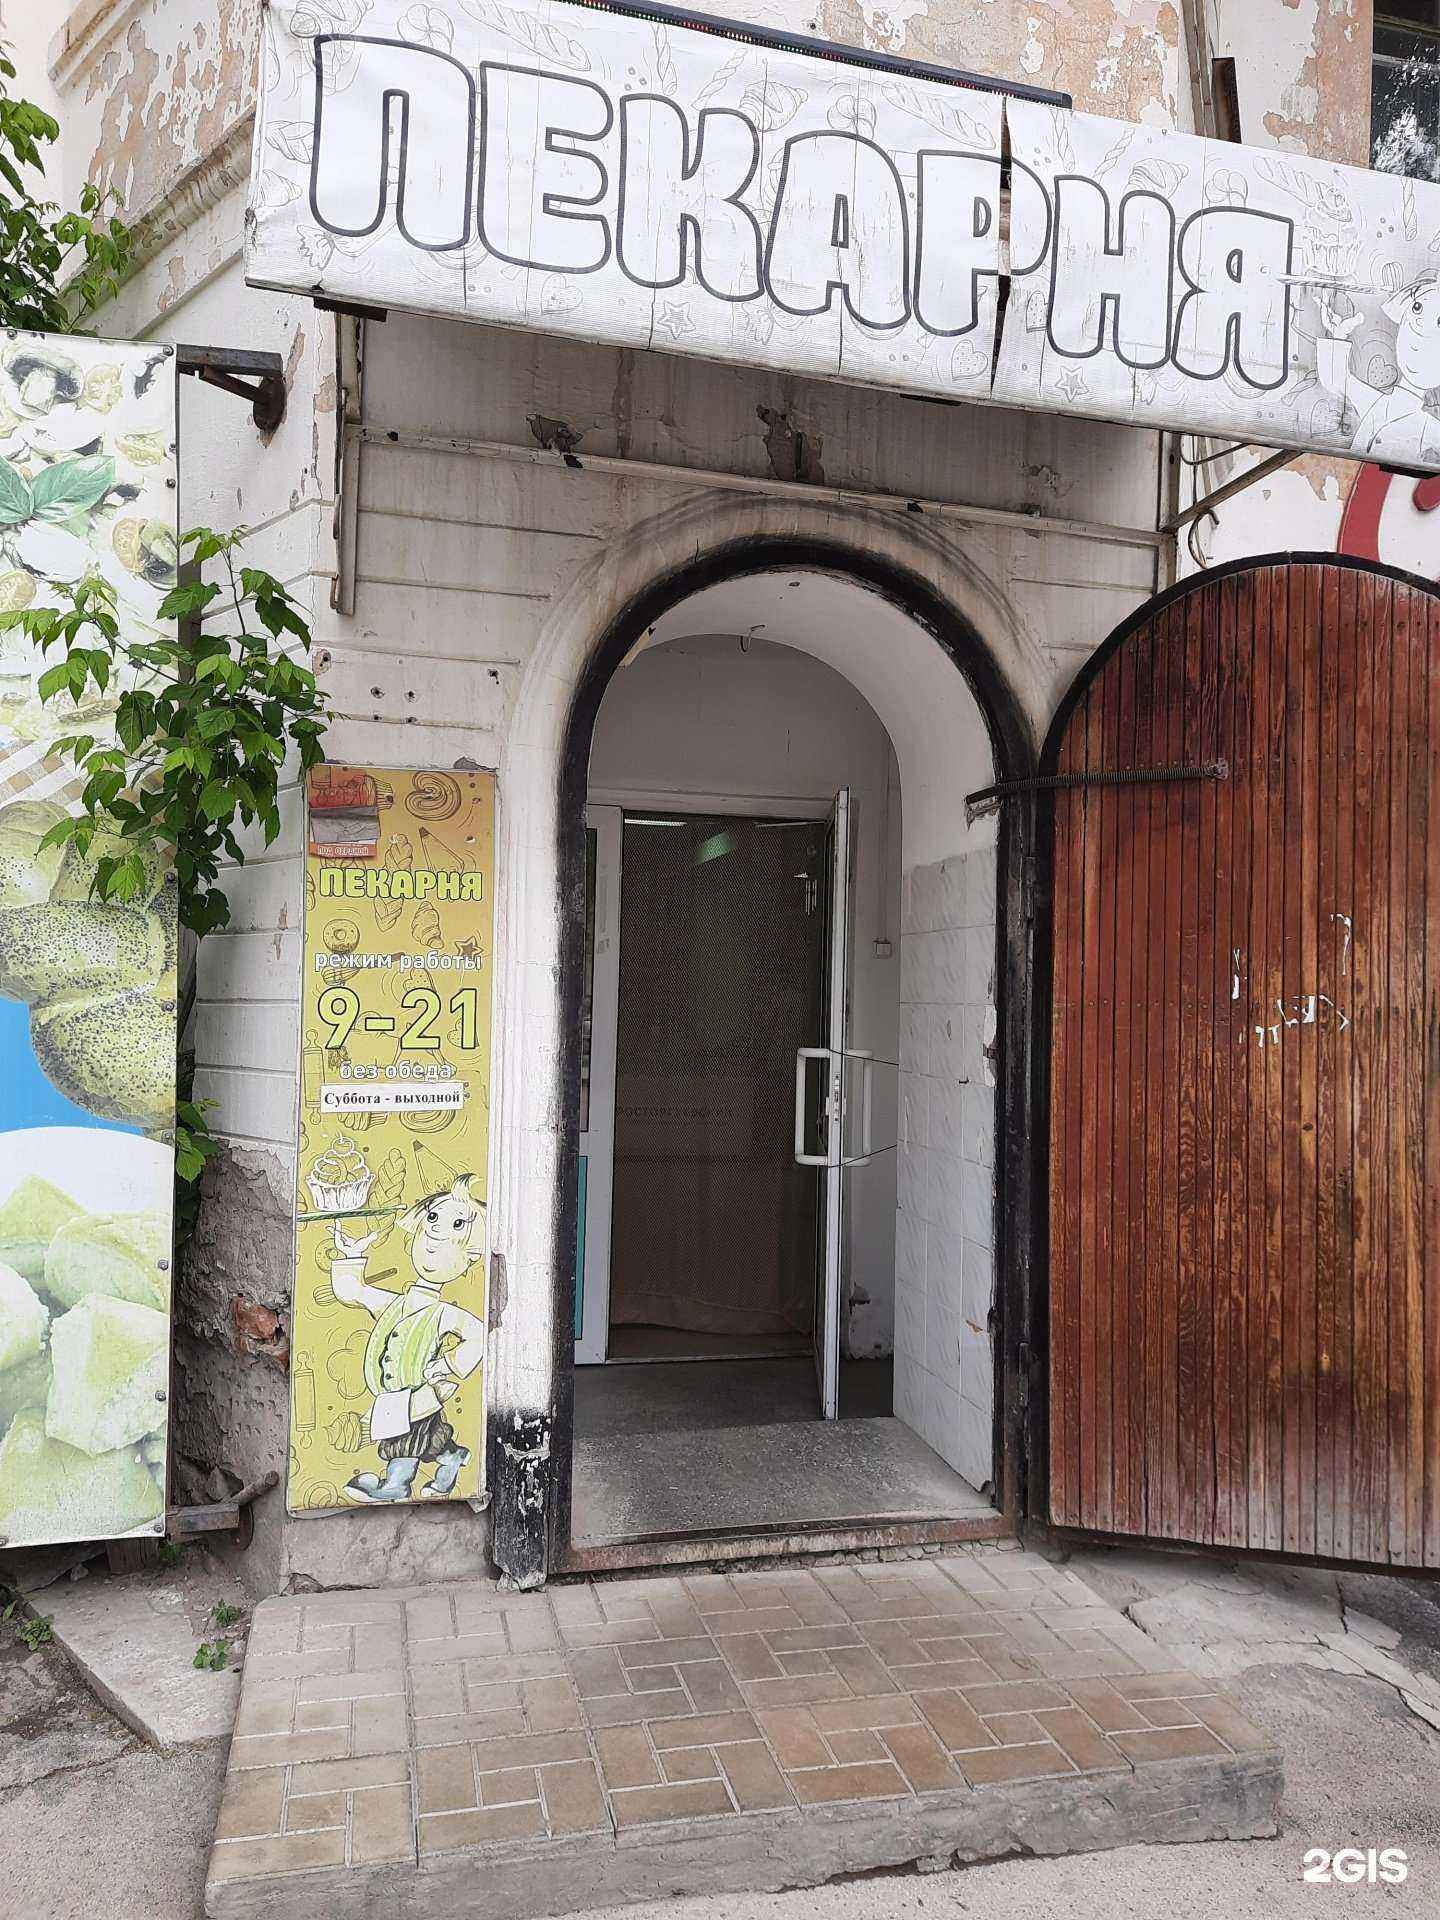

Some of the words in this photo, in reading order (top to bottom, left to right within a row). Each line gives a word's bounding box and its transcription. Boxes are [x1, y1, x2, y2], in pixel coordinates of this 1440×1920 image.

[311, 34, 1294, 390] ПЕКАРНЯ
[319, 867, 483, 901] ПЕКАРНЯ
[314, 952, 393, 972] режим
[400, 950, 482, 973] работы
[318, 986, 478, 1050] 9-21
[339, 1060, 379, 1079] без
[384, 1060, 454, 1082] обеда
[324, 1091, 381, 1108] Суббота
[395, 1090, 460, 1105] выходной
